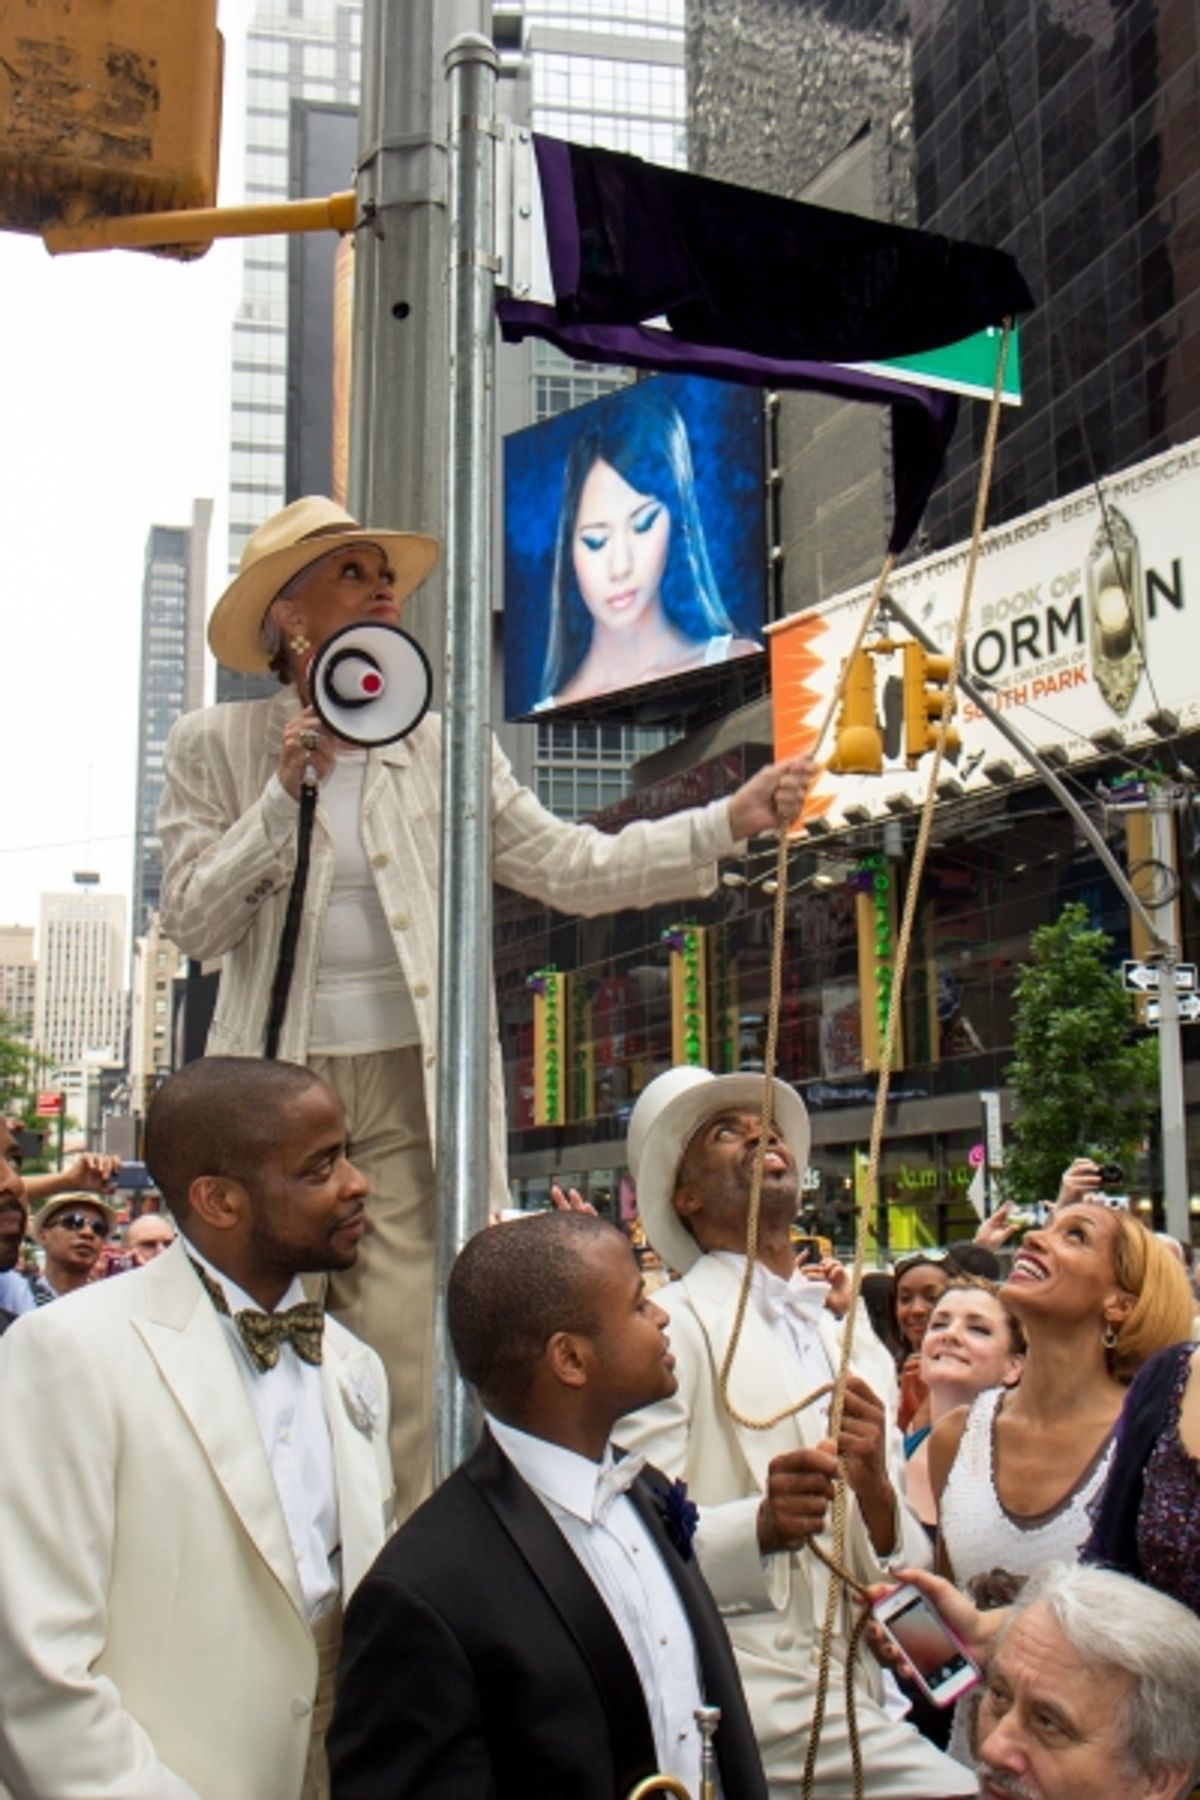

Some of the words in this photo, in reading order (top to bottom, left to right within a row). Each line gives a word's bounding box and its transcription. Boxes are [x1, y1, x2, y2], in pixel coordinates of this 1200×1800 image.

[1113, 450, 1200, 501] MUSICAL
[933, 612, 972, 643] TH
[980, 583, 1042, 628] BOOK
[1049, 567, 1083, 599] OF
[1031, 662, 1088, 700] PARK
